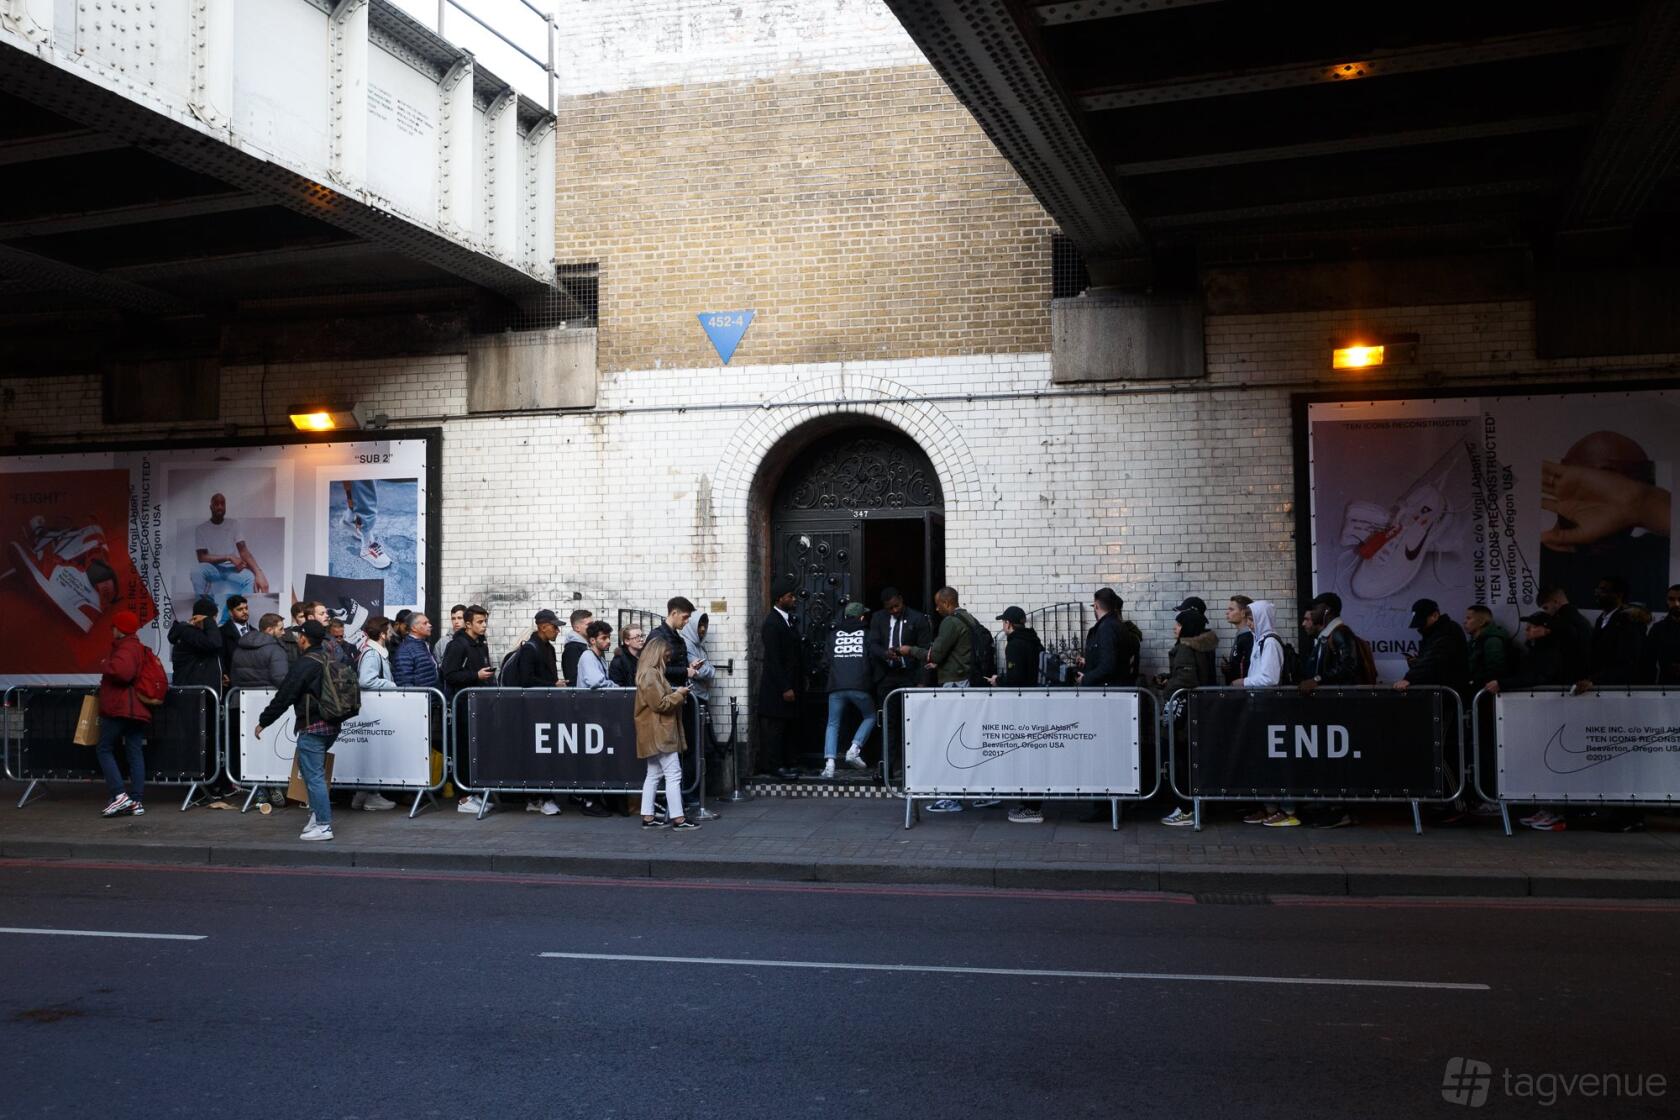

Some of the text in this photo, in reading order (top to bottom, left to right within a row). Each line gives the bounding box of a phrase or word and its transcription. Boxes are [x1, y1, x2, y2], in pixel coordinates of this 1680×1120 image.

[708, 315, 743, 328] 452-4
[1502, 465, 1513, 490] USA
[153, 504, 161, 527] USA
[1473, 524, 1483, 544] c/o
[1474, 547, 1484, 572] INC.
[1489, 532, 1500, 570] ICONS
[1474, 576, 1485, 605] NIKE
[835, 637, 863, 645] CDG
[535, 723, 614, 754] END.
[1002, 732, 1025, 740] ICONS
[1267, 724, 1361, 758] END.
